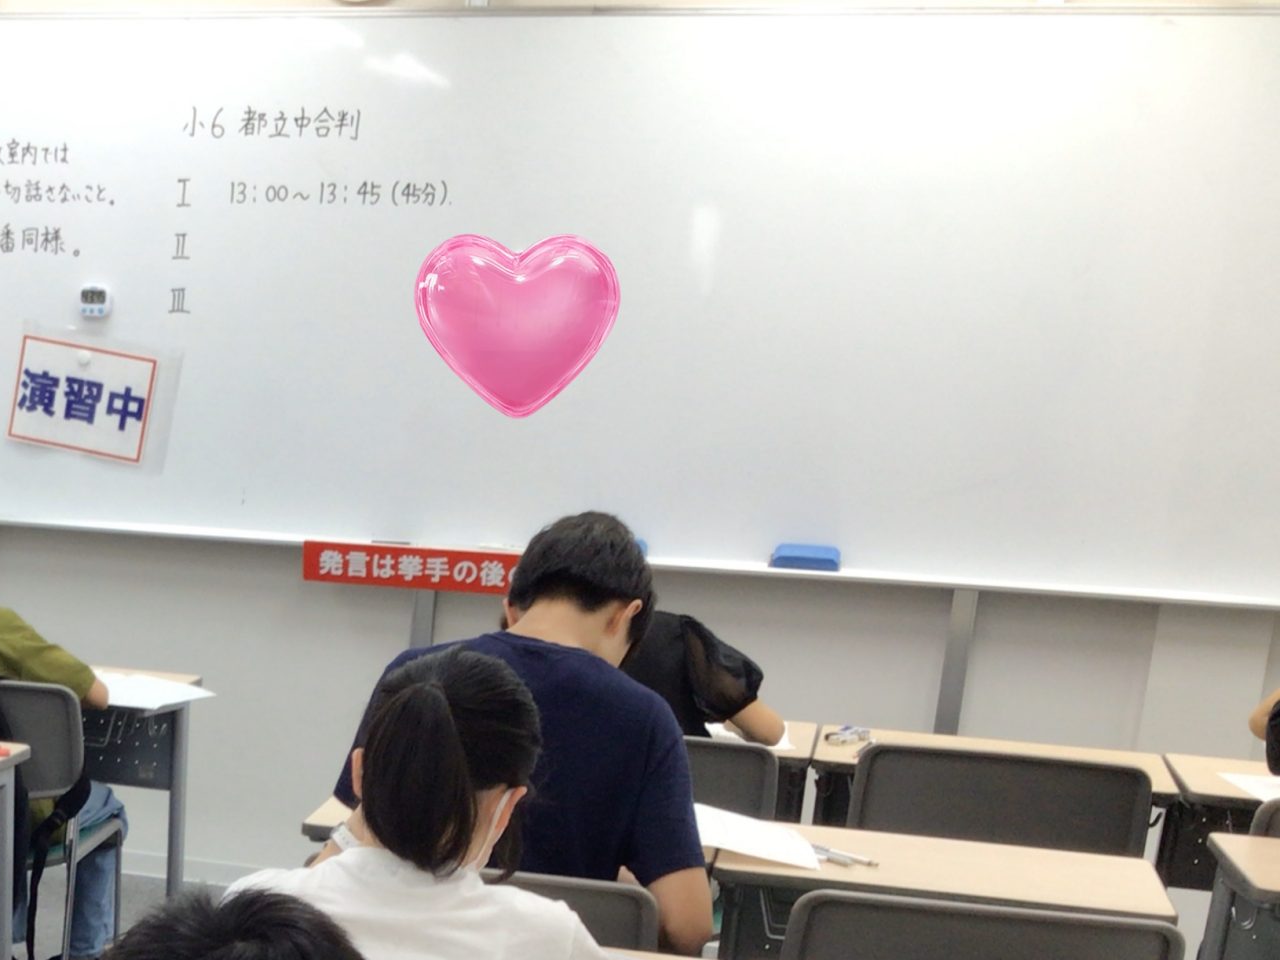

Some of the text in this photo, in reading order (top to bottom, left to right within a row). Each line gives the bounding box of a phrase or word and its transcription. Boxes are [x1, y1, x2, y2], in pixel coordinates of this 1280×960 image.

[238, 105, 362, 142] 都立中合判
[16, 366, 147, 433] 演習中
[319, 549, 517, 588] 発言は挙手の後
